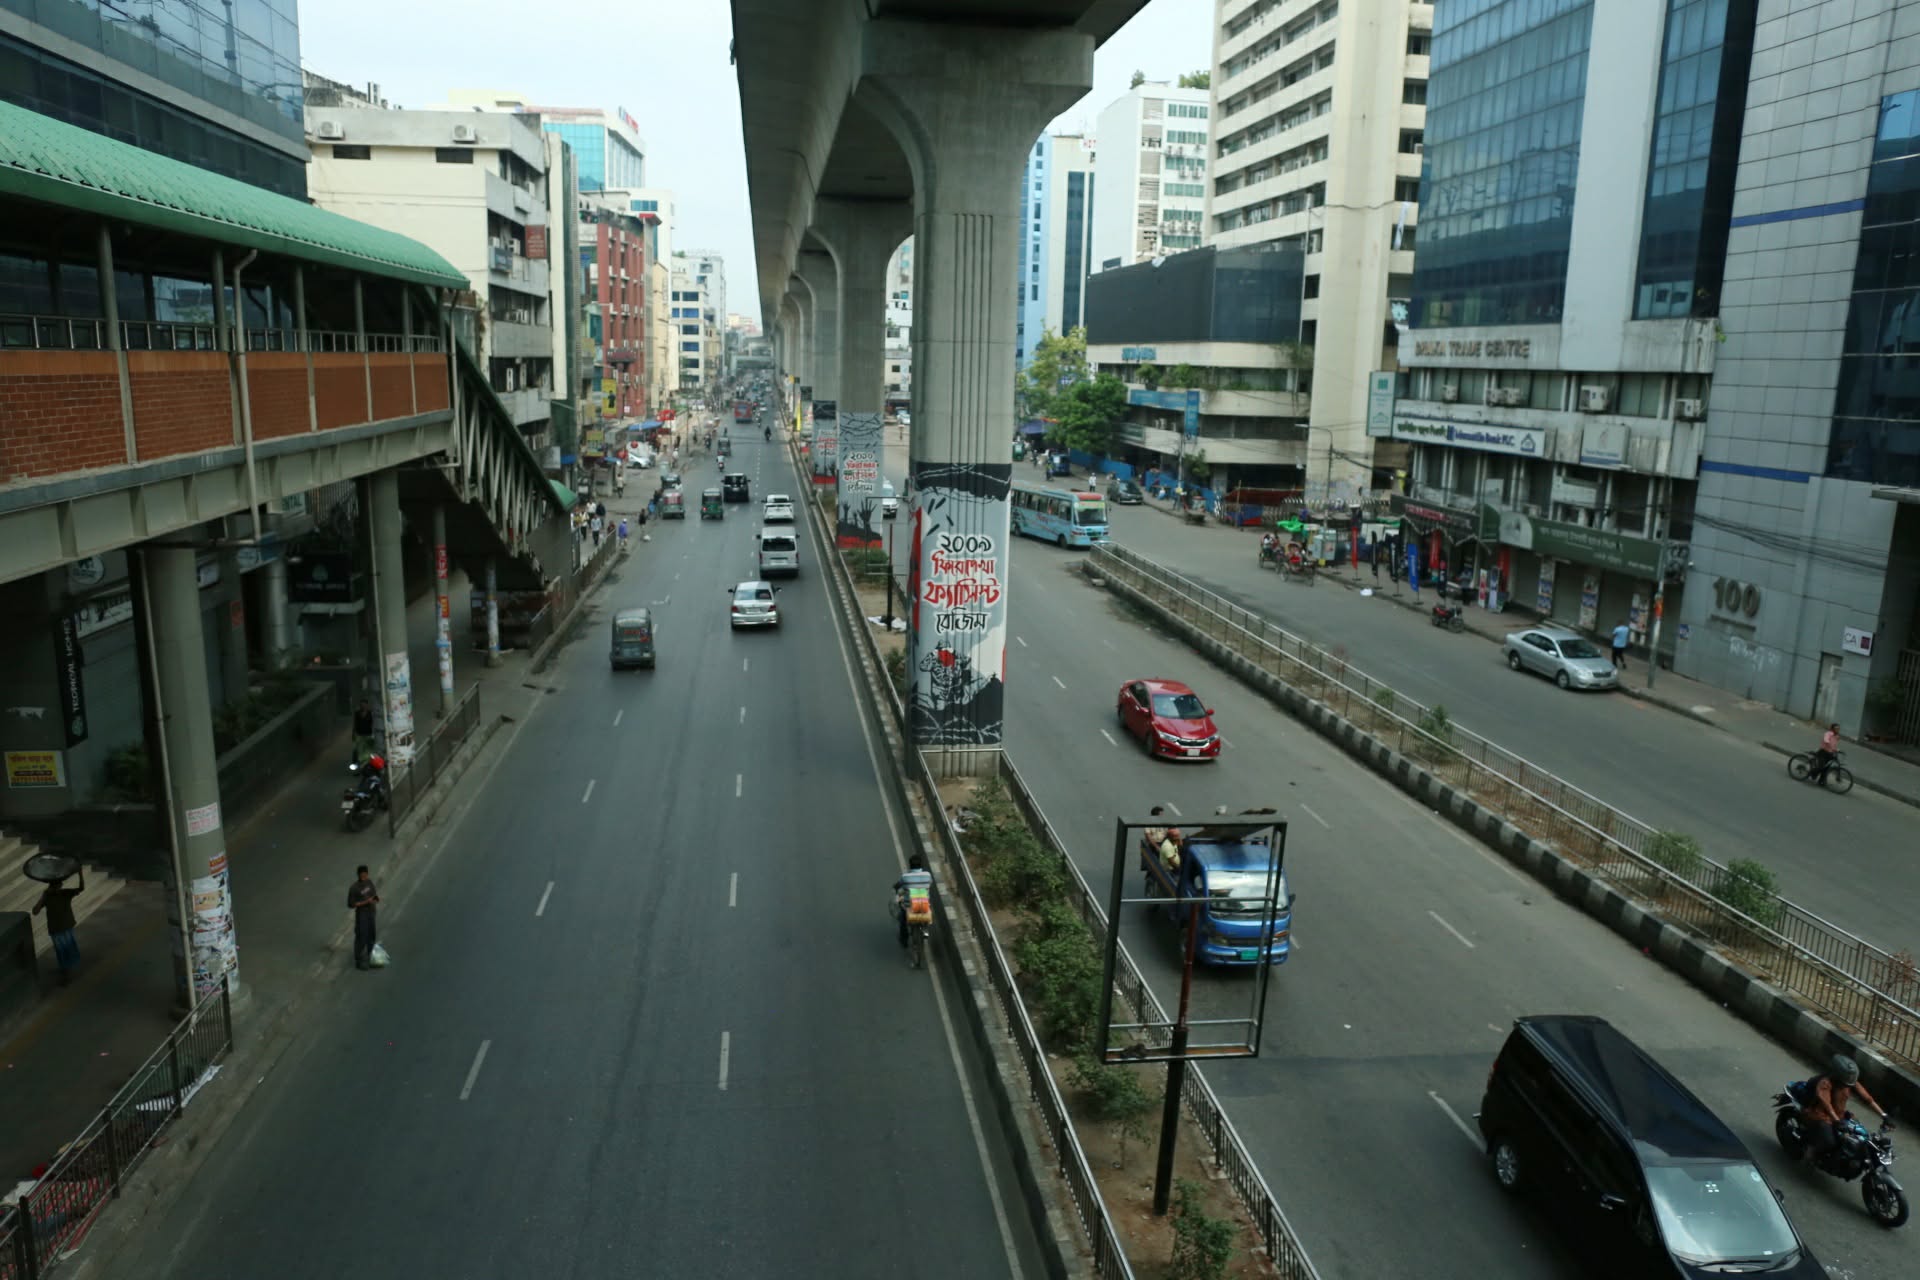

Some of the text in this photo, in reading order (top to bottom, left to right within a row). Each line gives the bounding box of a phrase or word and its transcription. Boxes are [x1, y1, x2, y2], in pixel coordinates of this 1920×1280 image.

[940, 535, 992, 553] ২০০৯
[924, 577, 1000, 608] ফ্যাসিস্ট
[1712, 576, 1761, 618] 100
[936, 607, 988, 633] রেজিম
